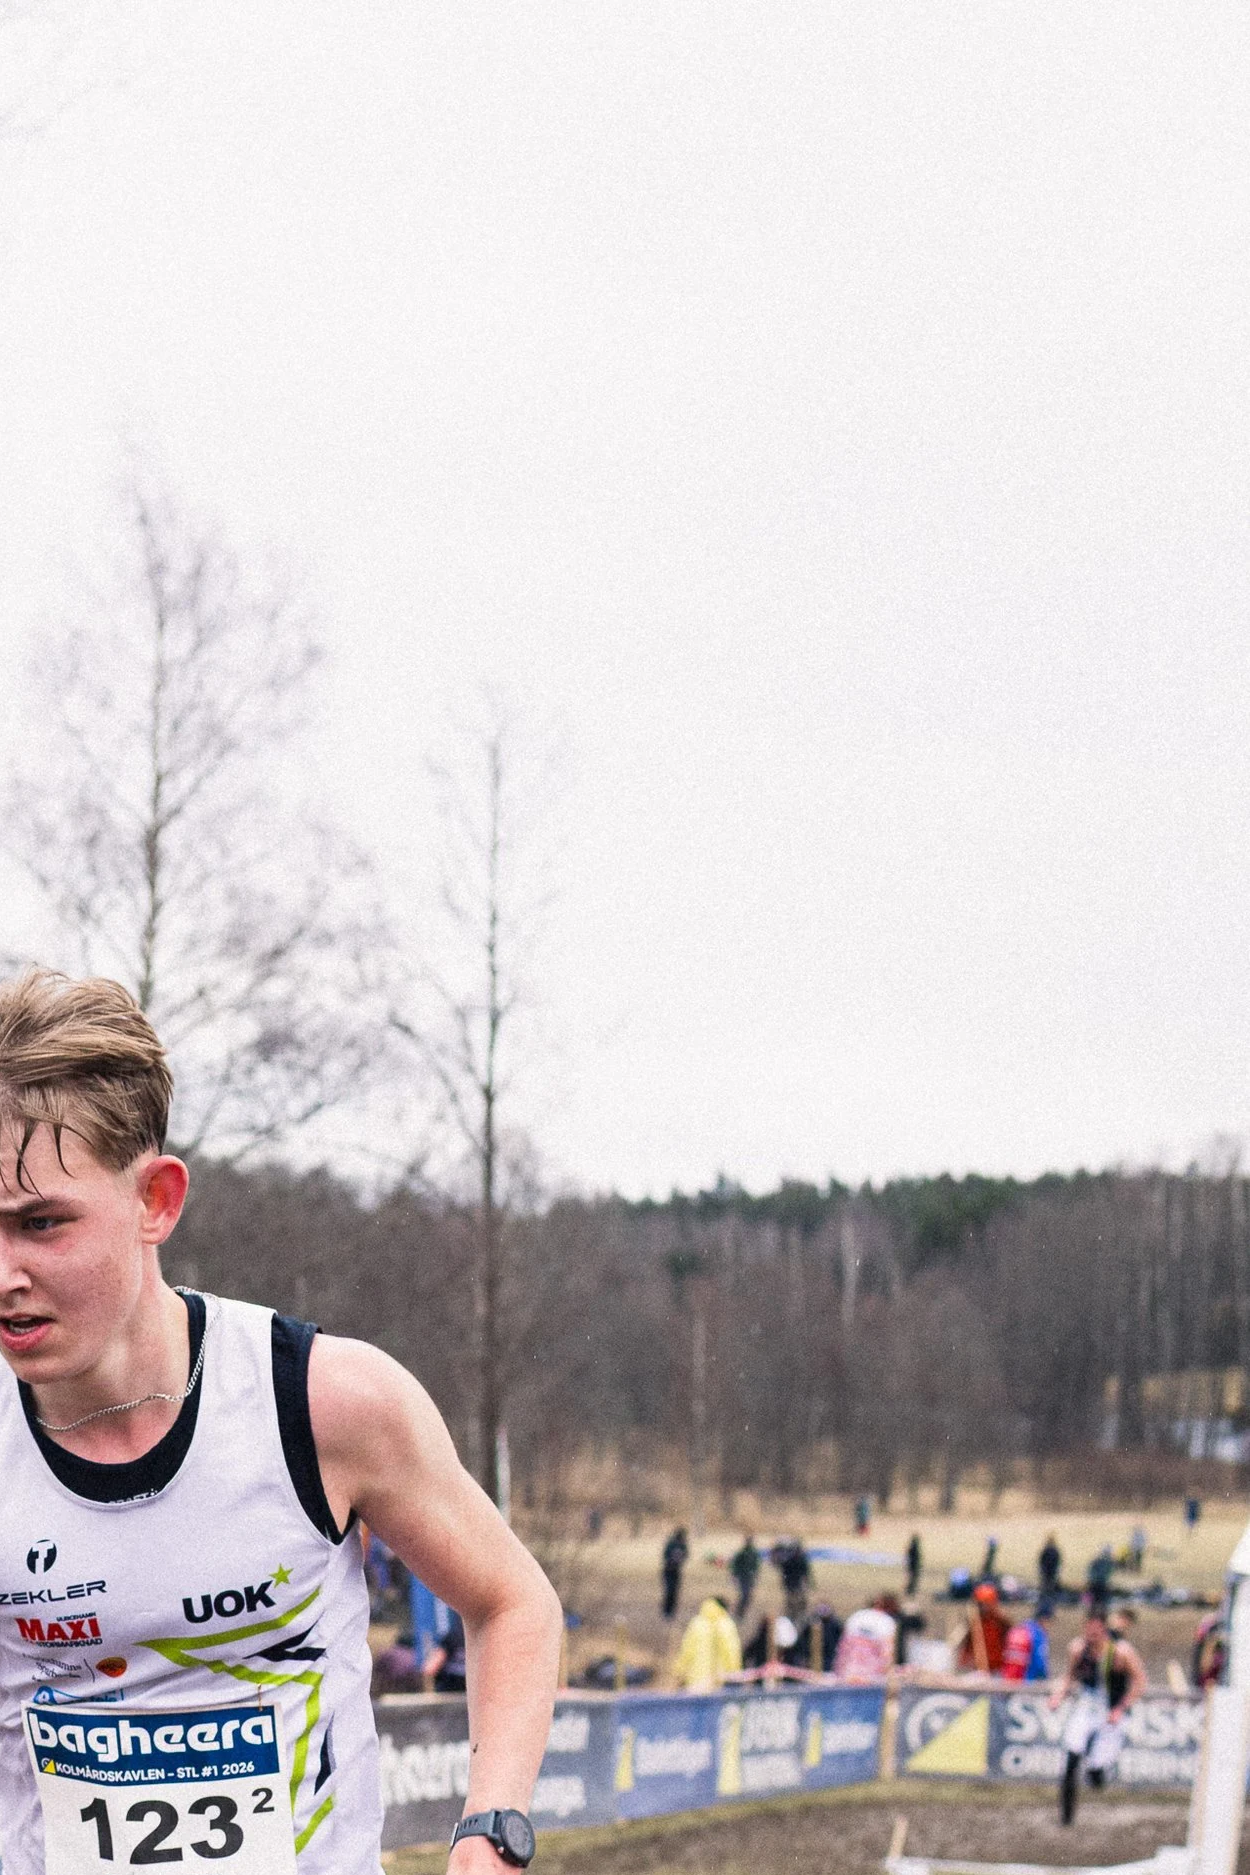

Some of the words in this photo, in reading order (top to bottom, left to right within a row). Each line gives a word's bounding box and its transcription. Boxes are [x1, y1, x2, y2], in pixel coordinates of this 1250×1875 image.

[182, 1580, 276, 1623] UOK
[15, 1618, 101, 1641] MAXI
[28, 1713, 274, 1762] bagheera
[56, 1764, 165, 1782] KOLMÅRDSKAVLEN
[177, 1767, 199, 1779] STL
[201, 1765, 218, 1777] #1
[222, 1761, 255, 1775] 2026
[80, 1796, 244, 1865] 123
[252, 1787, 275, 1814] 2
